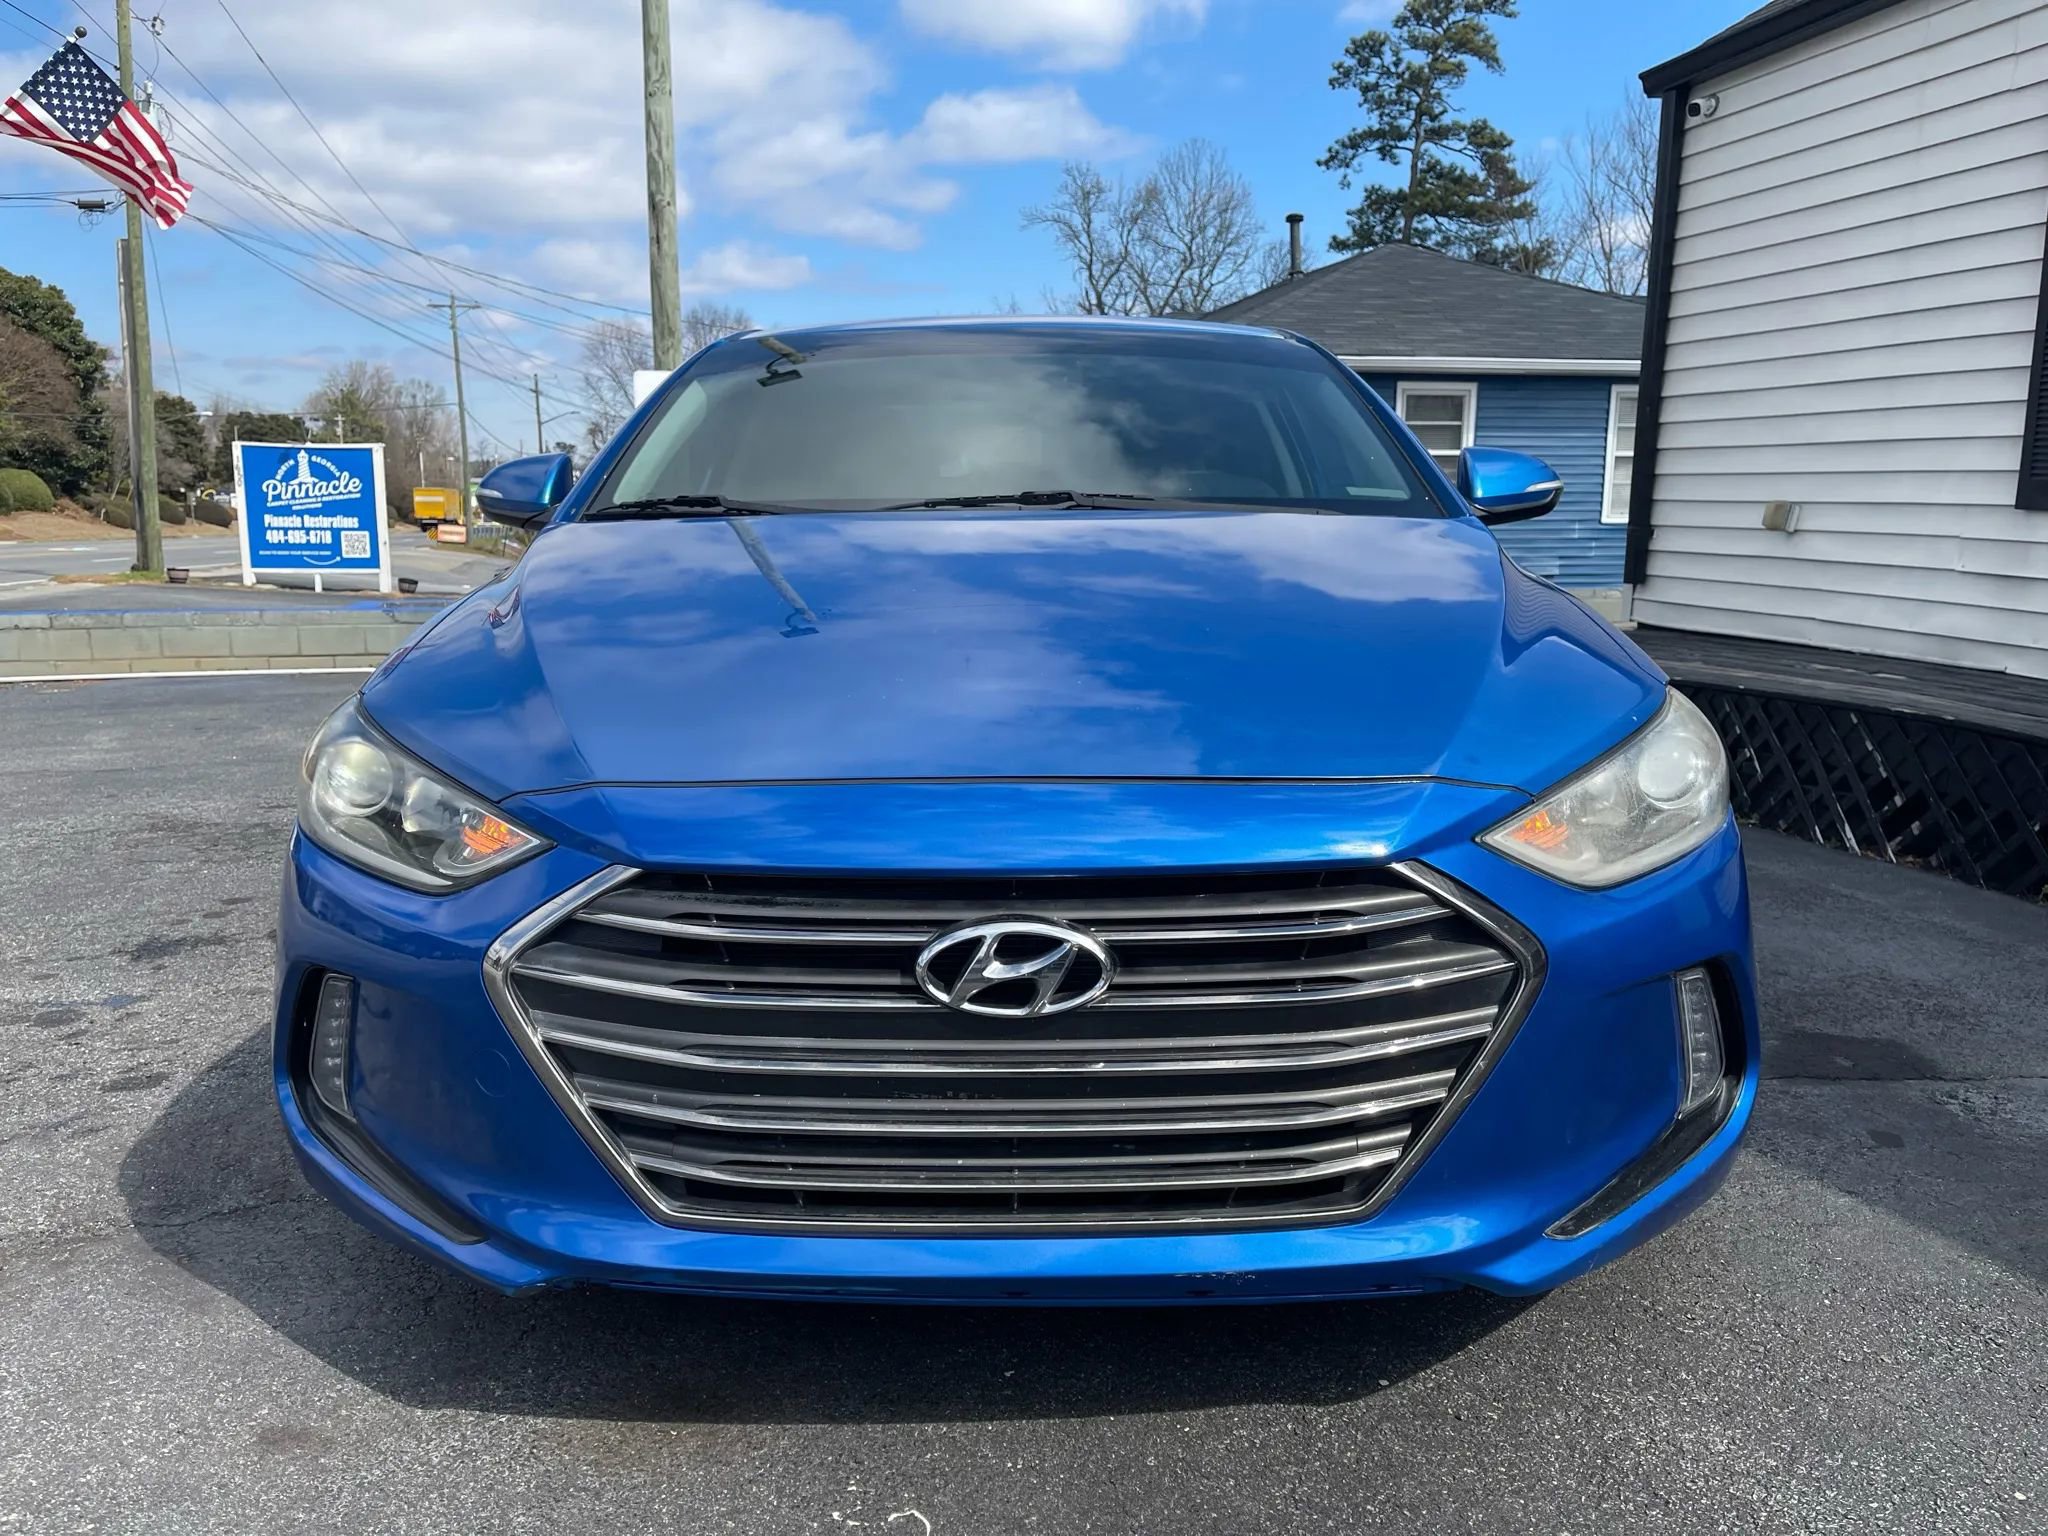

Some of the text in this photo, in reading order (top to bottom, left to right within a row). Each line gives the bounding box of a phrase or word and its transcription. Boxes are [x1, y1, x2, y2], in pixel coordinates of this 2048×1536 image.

[311, 455, 341, 477] GEORGIA
[262, 471, 363, 502] Pinnacle
[264, 514, 359, 529] Pinnacle Restorations
